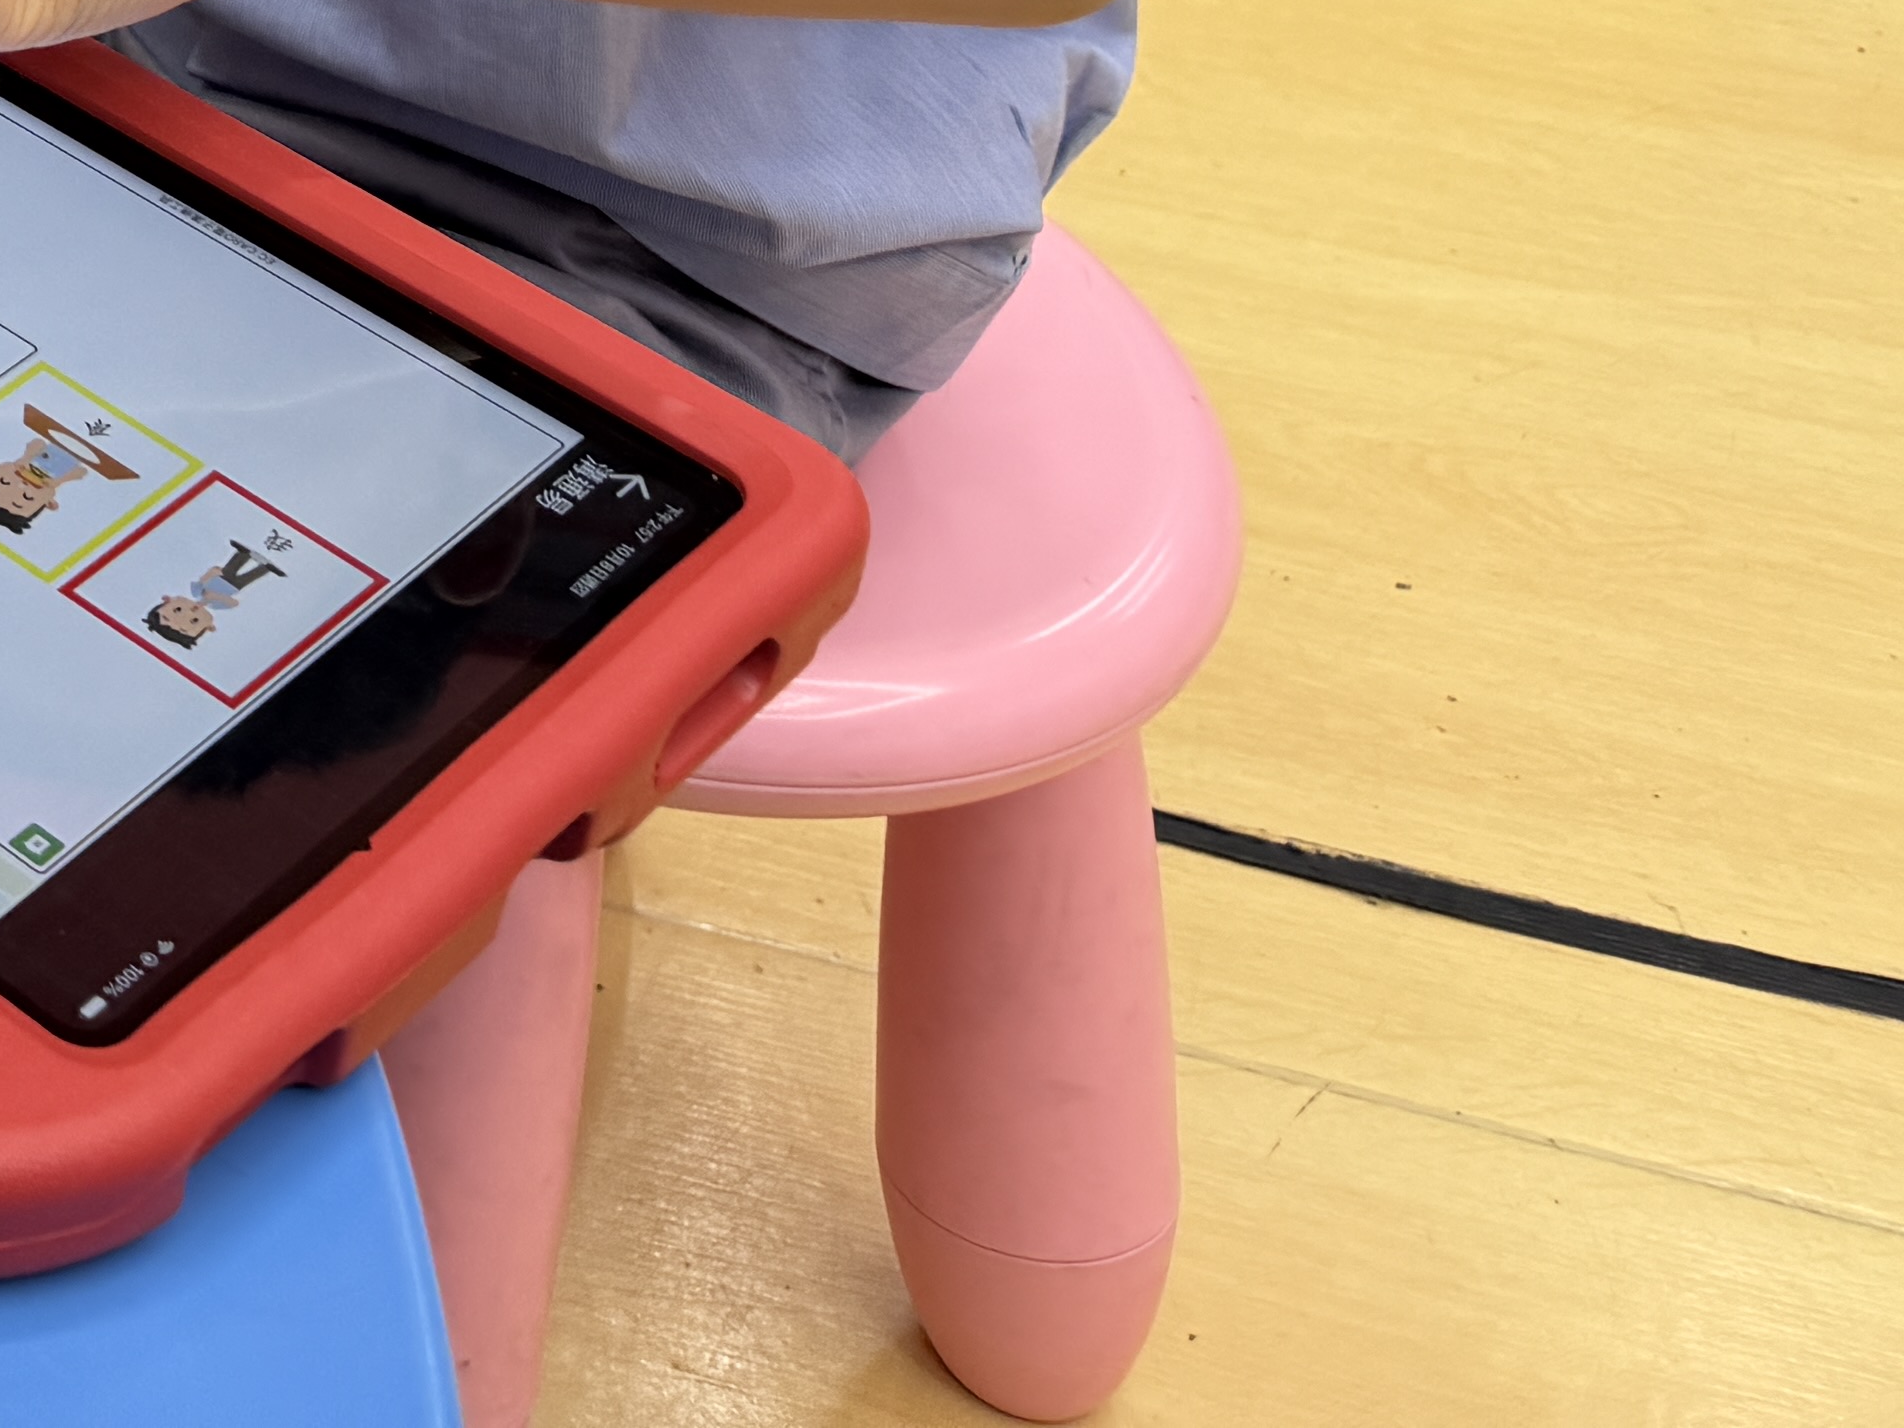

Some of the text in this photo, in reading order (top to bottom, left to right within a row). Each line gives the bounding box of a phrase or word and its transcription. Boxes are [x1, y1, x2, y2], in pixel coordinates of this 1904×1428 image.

[85, 419, 111, 436] 食
[536, 455, 614, 516] 溝通易
[264, 529, 293, 552] 我
[103, 964, 144, 997] 100%
